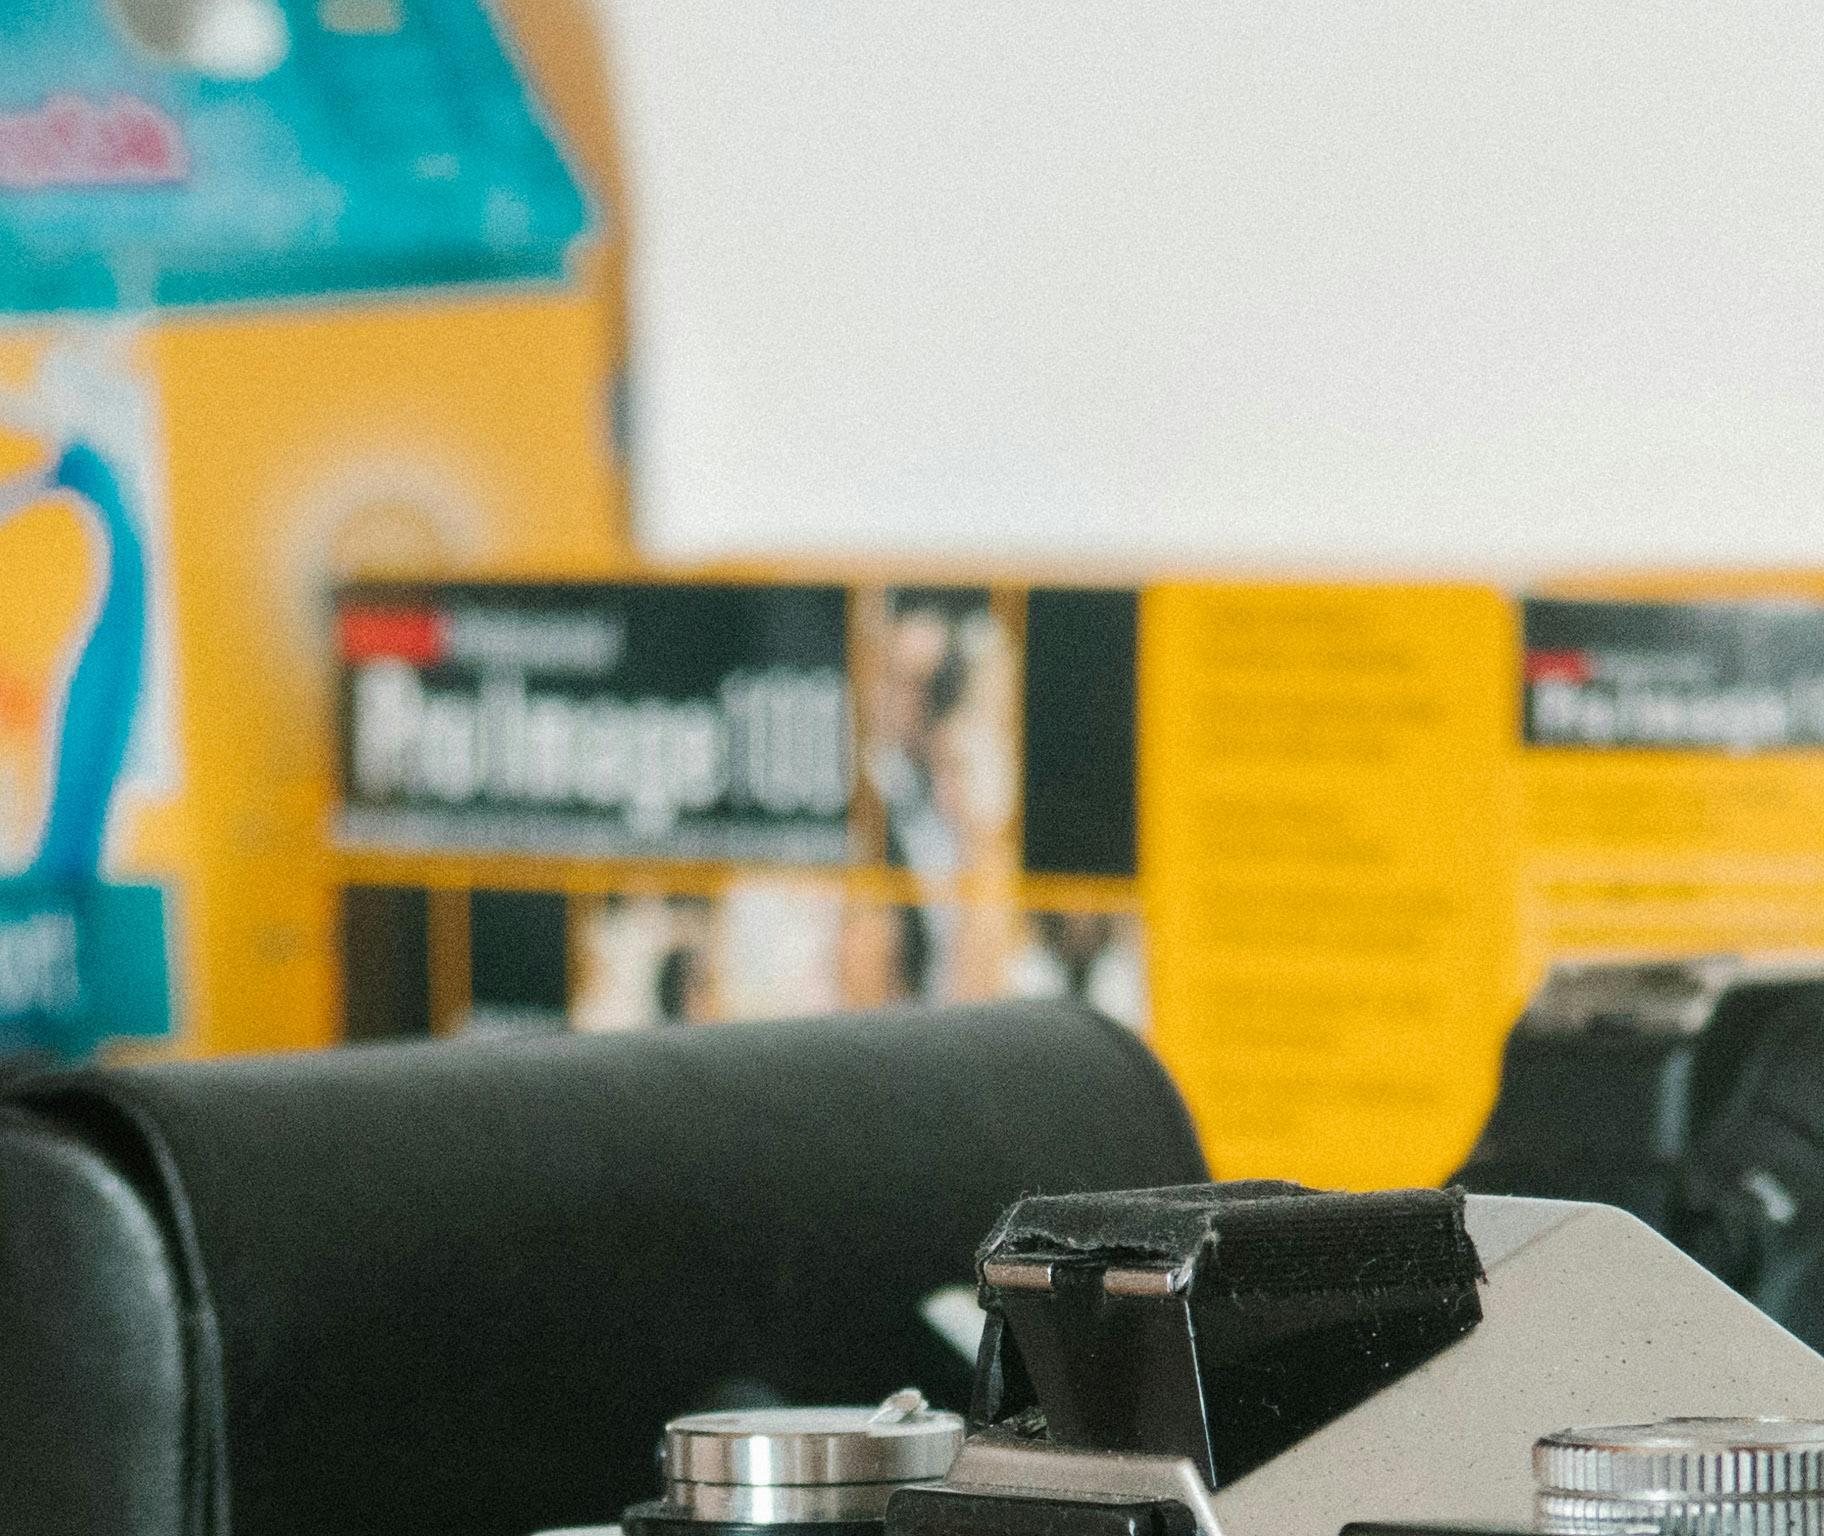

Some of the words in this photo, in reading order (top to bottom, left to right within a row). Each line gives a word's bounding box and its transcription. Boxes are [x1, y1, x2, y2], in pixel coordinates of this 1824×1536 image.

[354, 662, 476, 802] Pro
[481, 668, 723, 840] Image
[1622, 688, 1788, 758] Image
